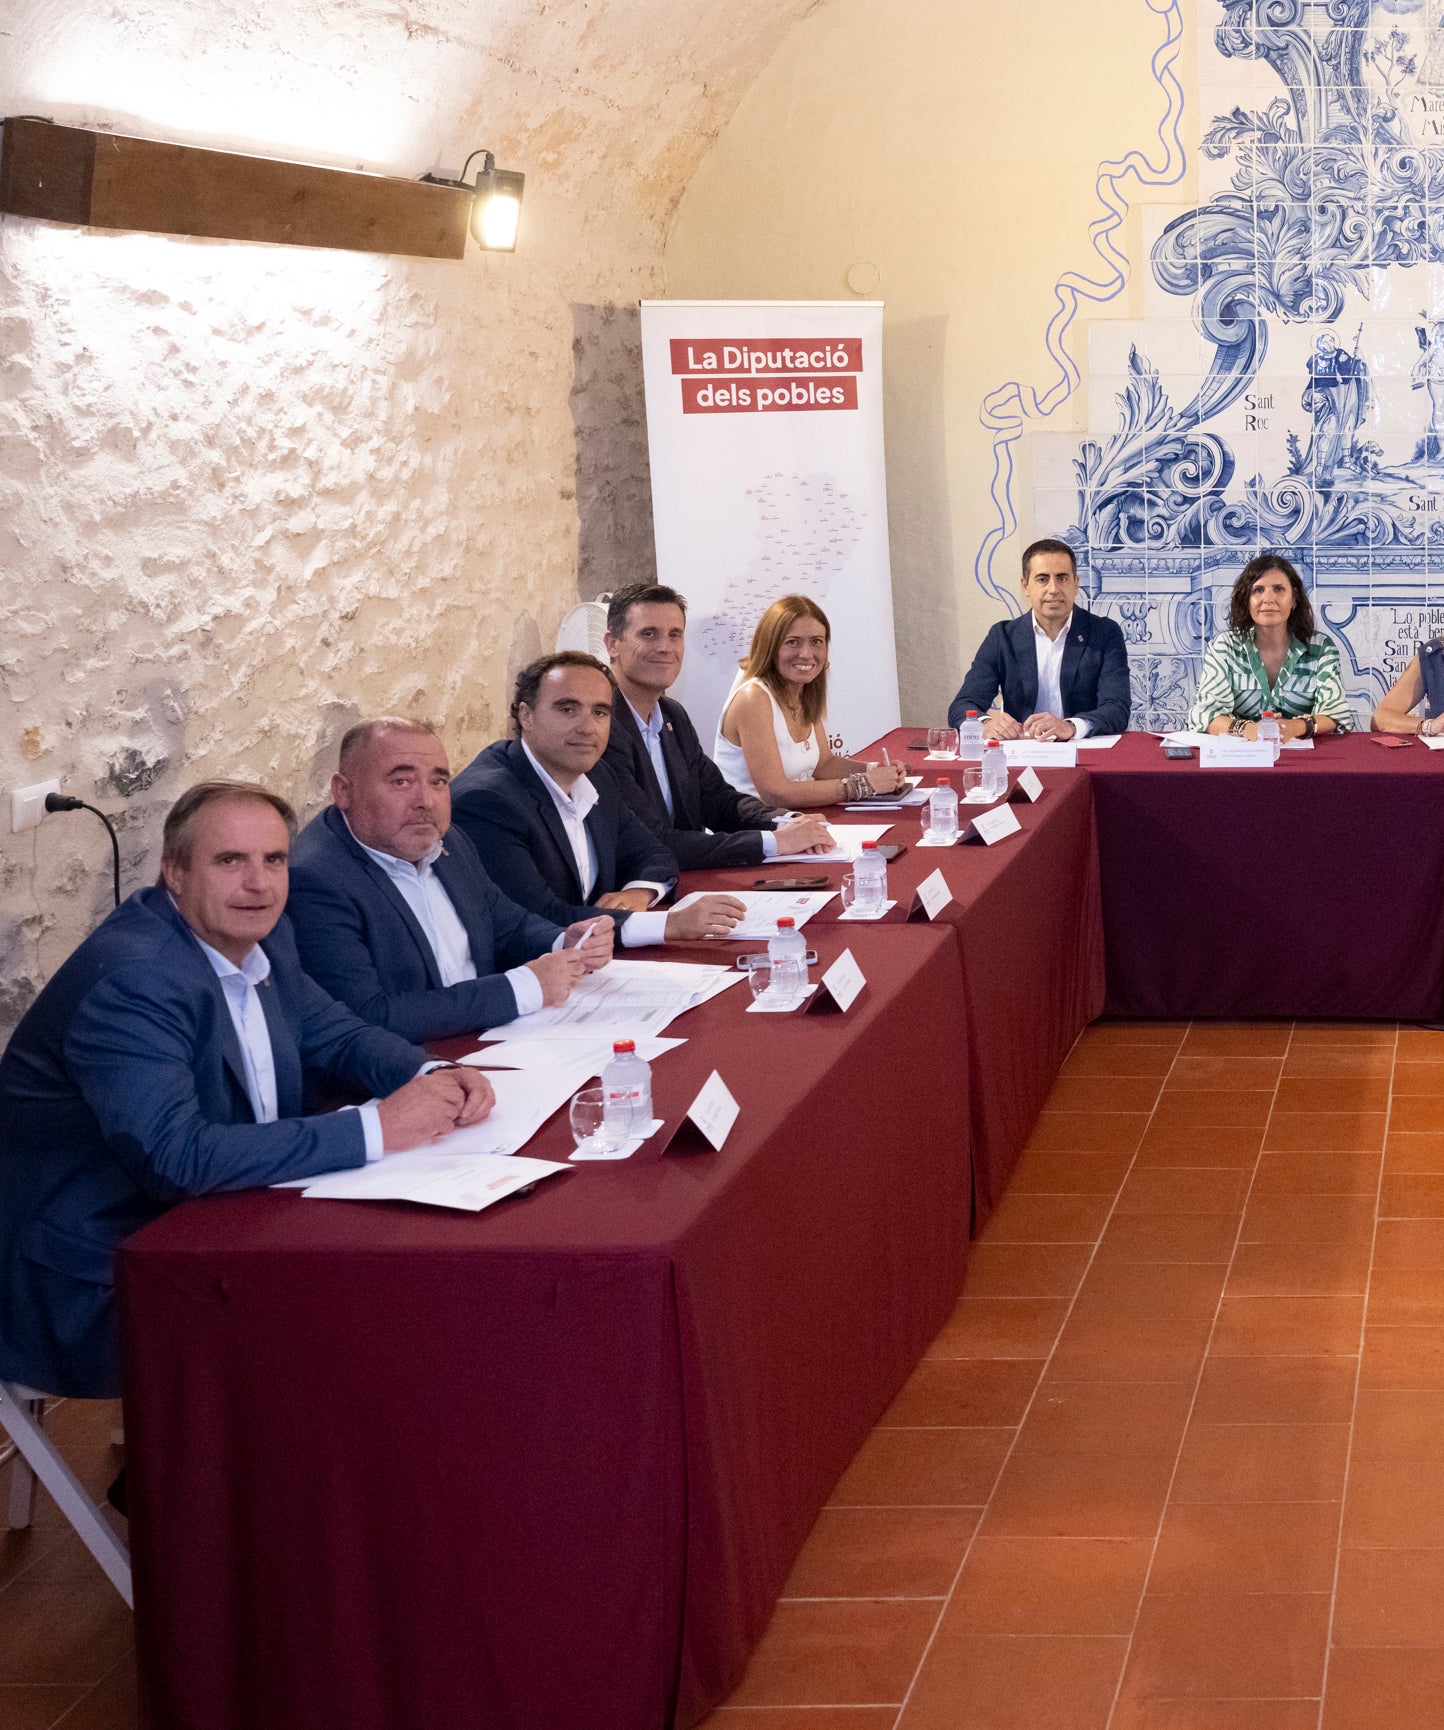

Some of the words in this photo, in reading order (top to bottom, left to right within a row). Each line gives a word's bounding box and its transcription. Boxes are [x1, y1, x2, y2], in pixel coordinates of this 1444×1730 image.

[1410, 95, 1444, 112] Mare
[687, 346, 718, 370] La
[722, 344, 849, 374] Diputació
[696, 383, 752, 407] dels
[756, 382, 845, 411] pobles
[1244, 394, 1275, 411] Sant
[1245, 414, 1270, 431] Roc
[1408, 495, 1438, 511] Sant
[1398, 624, 1419, 639] està
[1384, 639, 1409, 656] San
